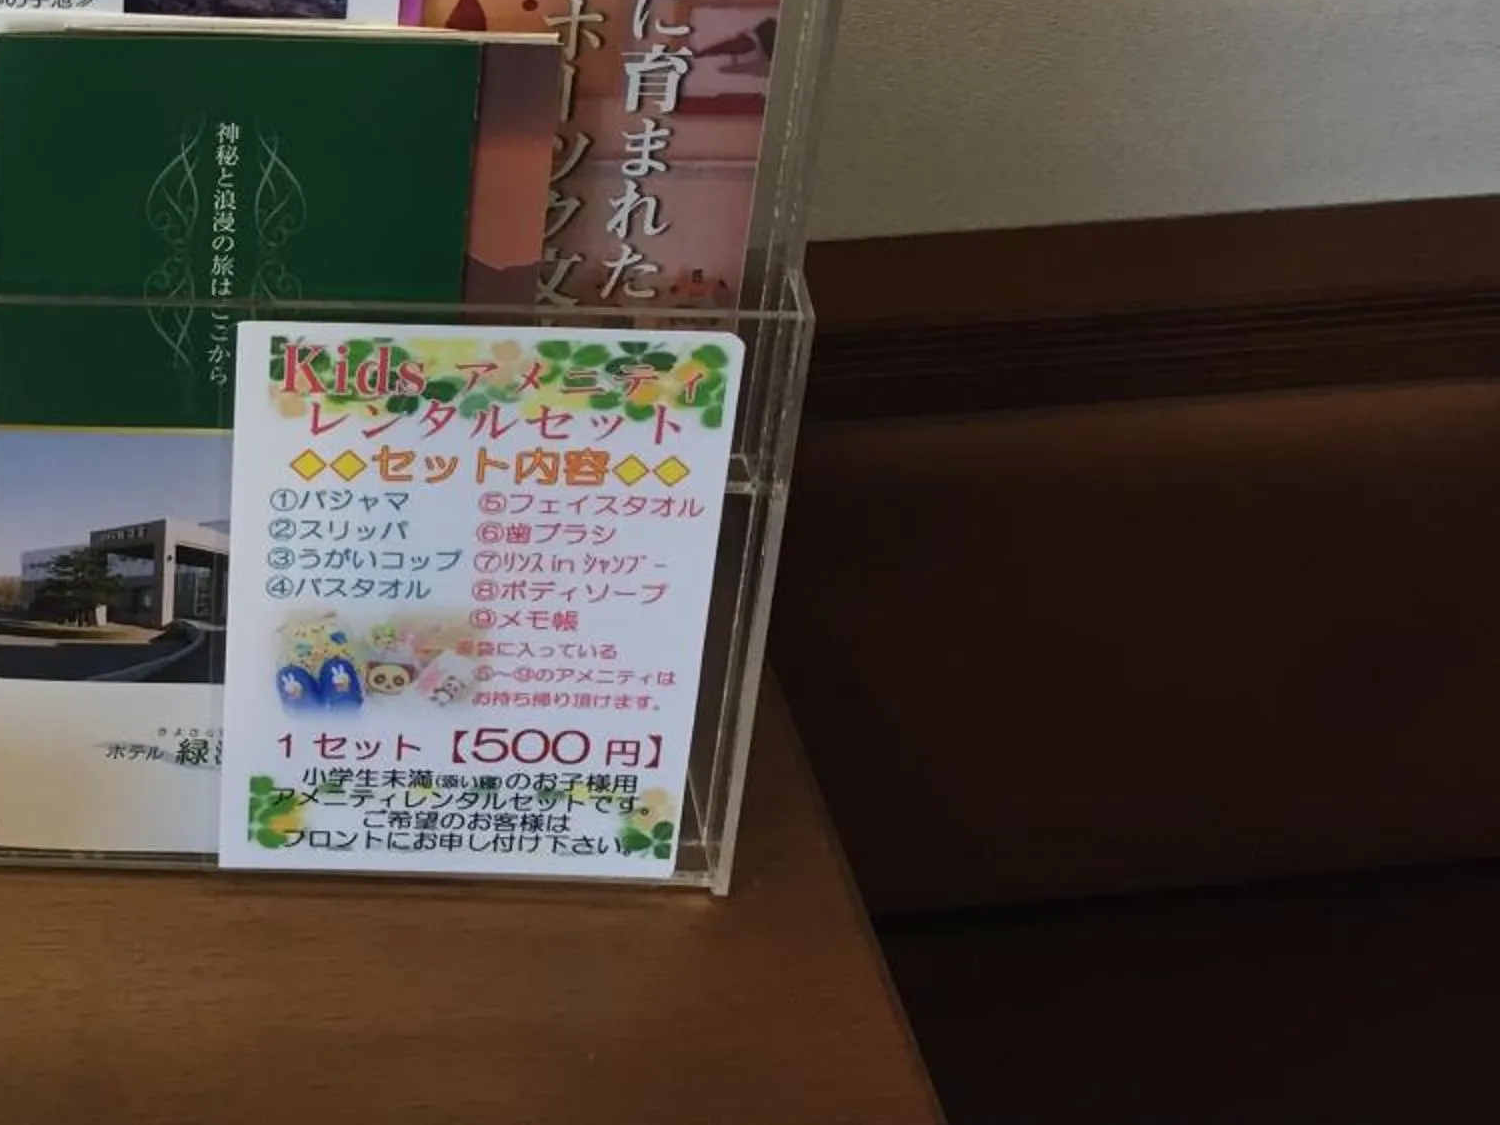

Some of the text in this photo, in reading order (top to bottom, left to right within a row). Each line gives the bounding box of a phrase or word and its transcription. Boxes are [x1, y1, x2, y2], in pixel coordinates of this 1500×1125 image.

[206, 121, 241, 386] 神秘と浪漫の旅はここから
[280, 341, 706, 404] Kids アメニティ
[308, 398, 683, 445] レンタルセット
[372, 444, 610, 488] セット内容
[364, 809, 571, 834] ご希望のお客様は
